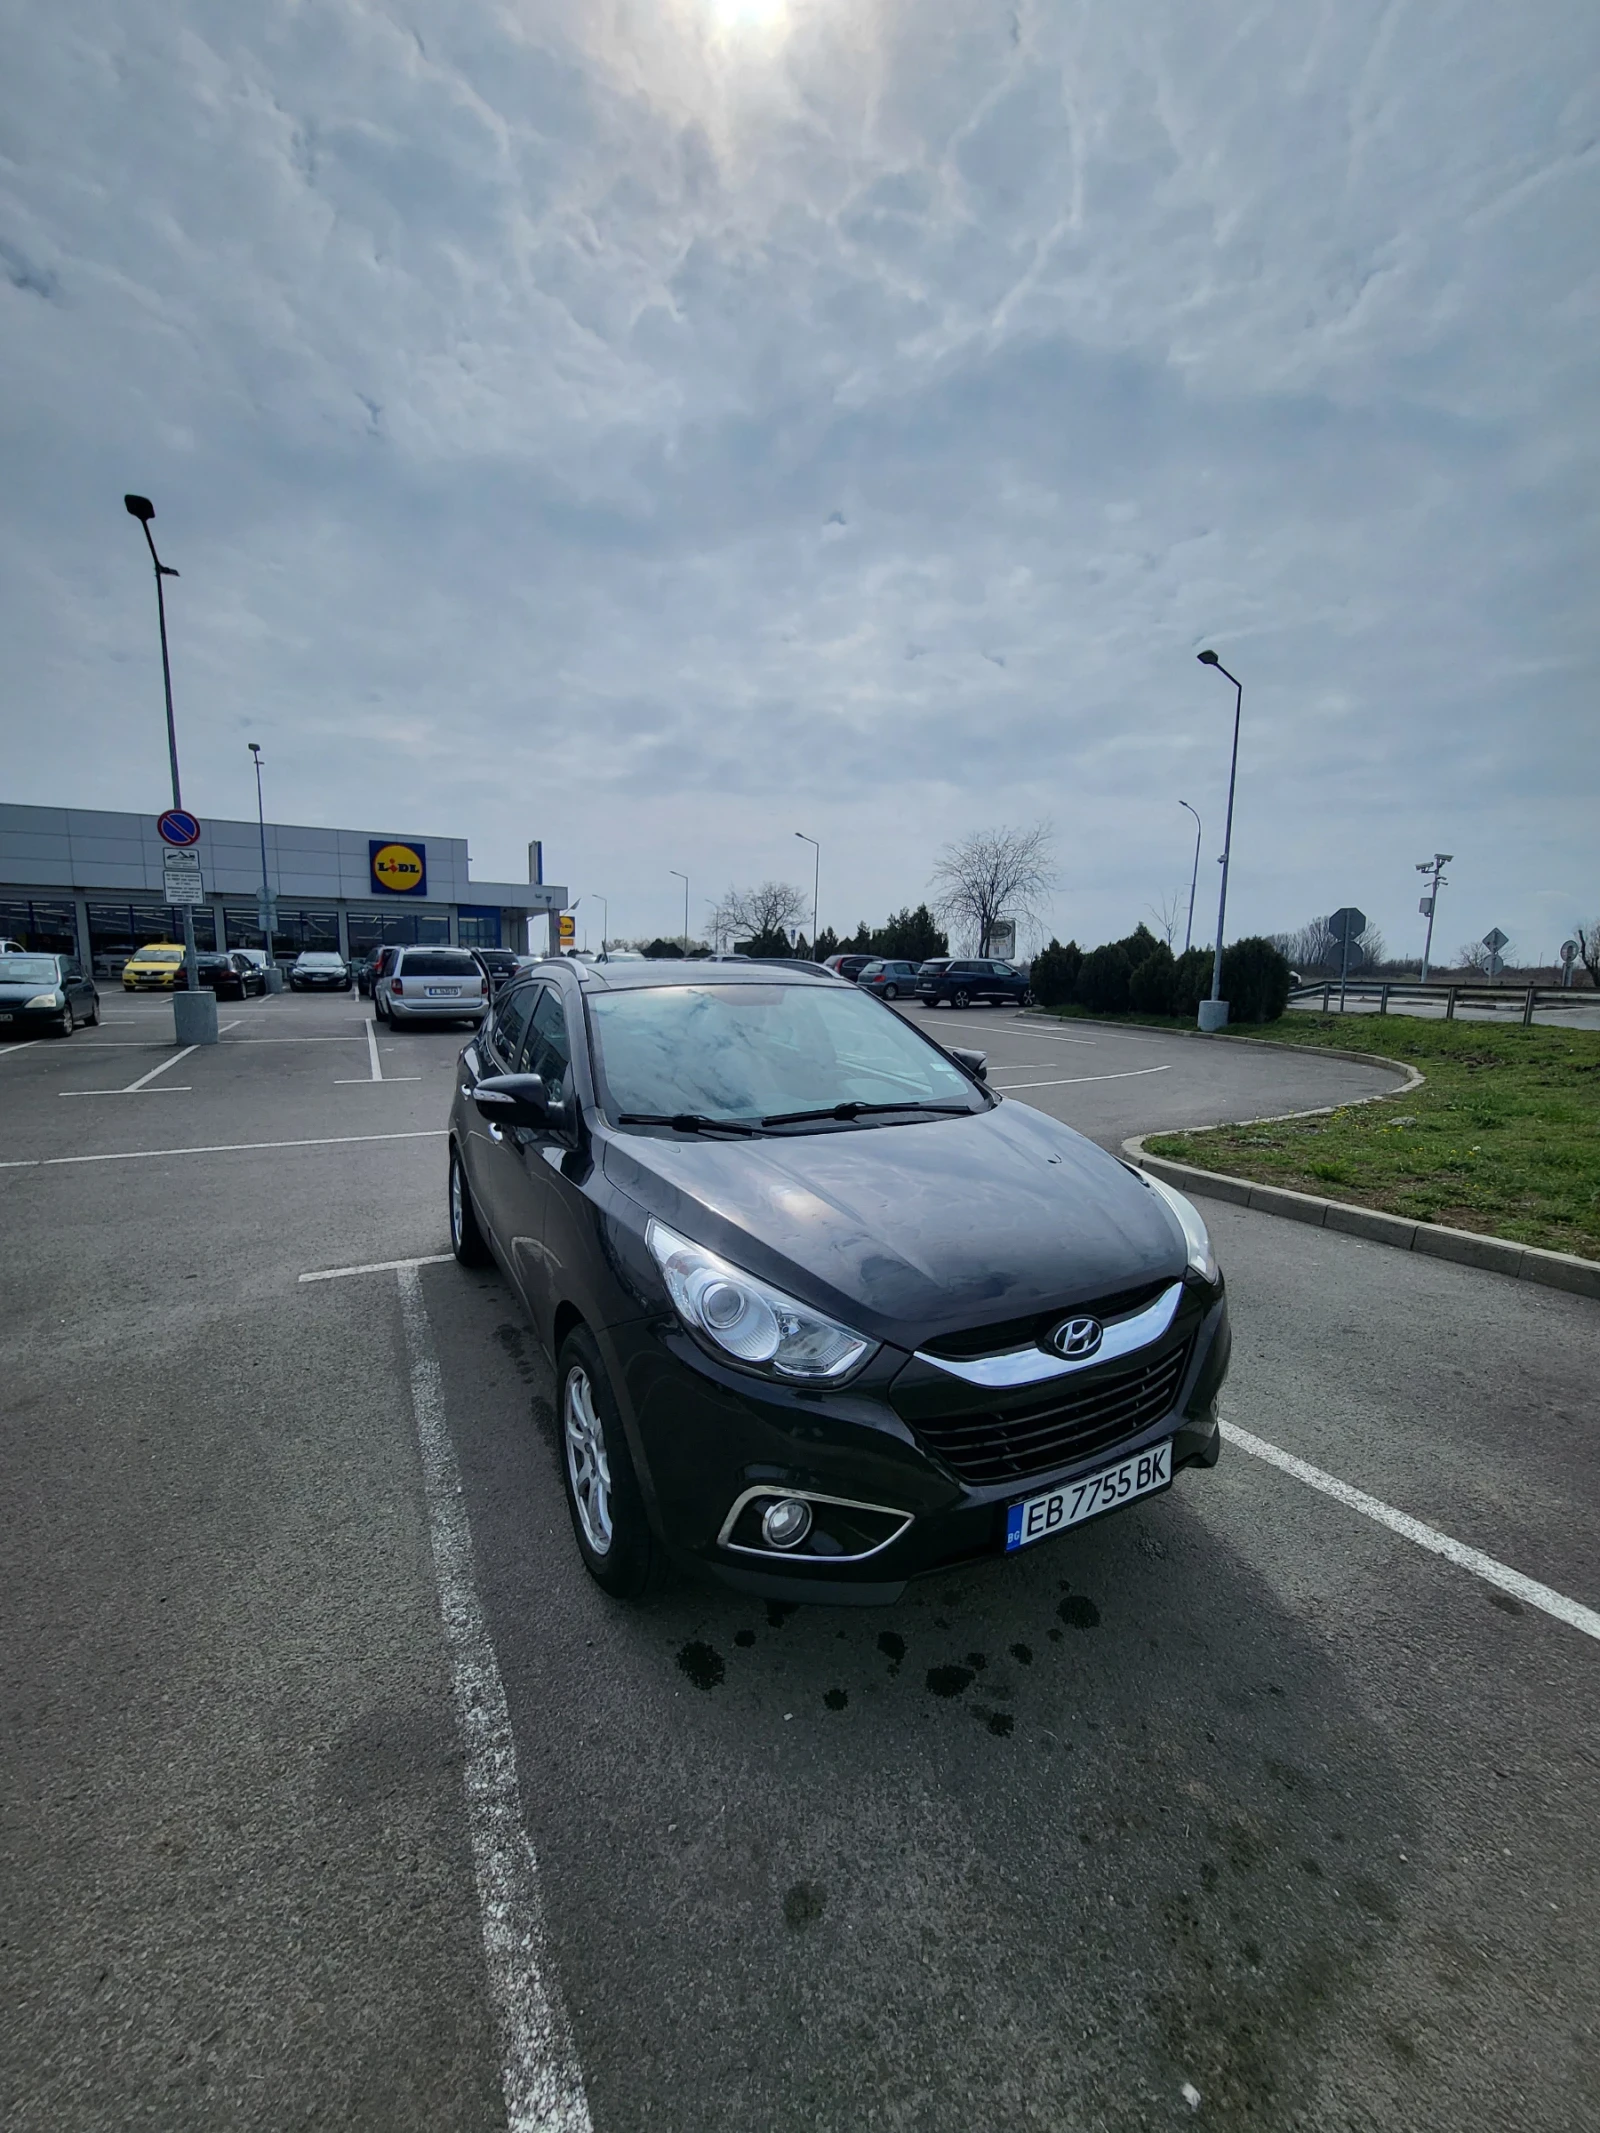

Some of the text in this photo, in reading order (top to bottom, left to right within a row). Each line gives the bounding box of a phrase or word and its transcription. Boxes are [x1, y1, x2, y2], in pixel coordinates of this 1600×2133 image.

[1026, 1448, 1167, 1537] EB 7755 BK
[1007, 1530, 1020, 1544] BG
